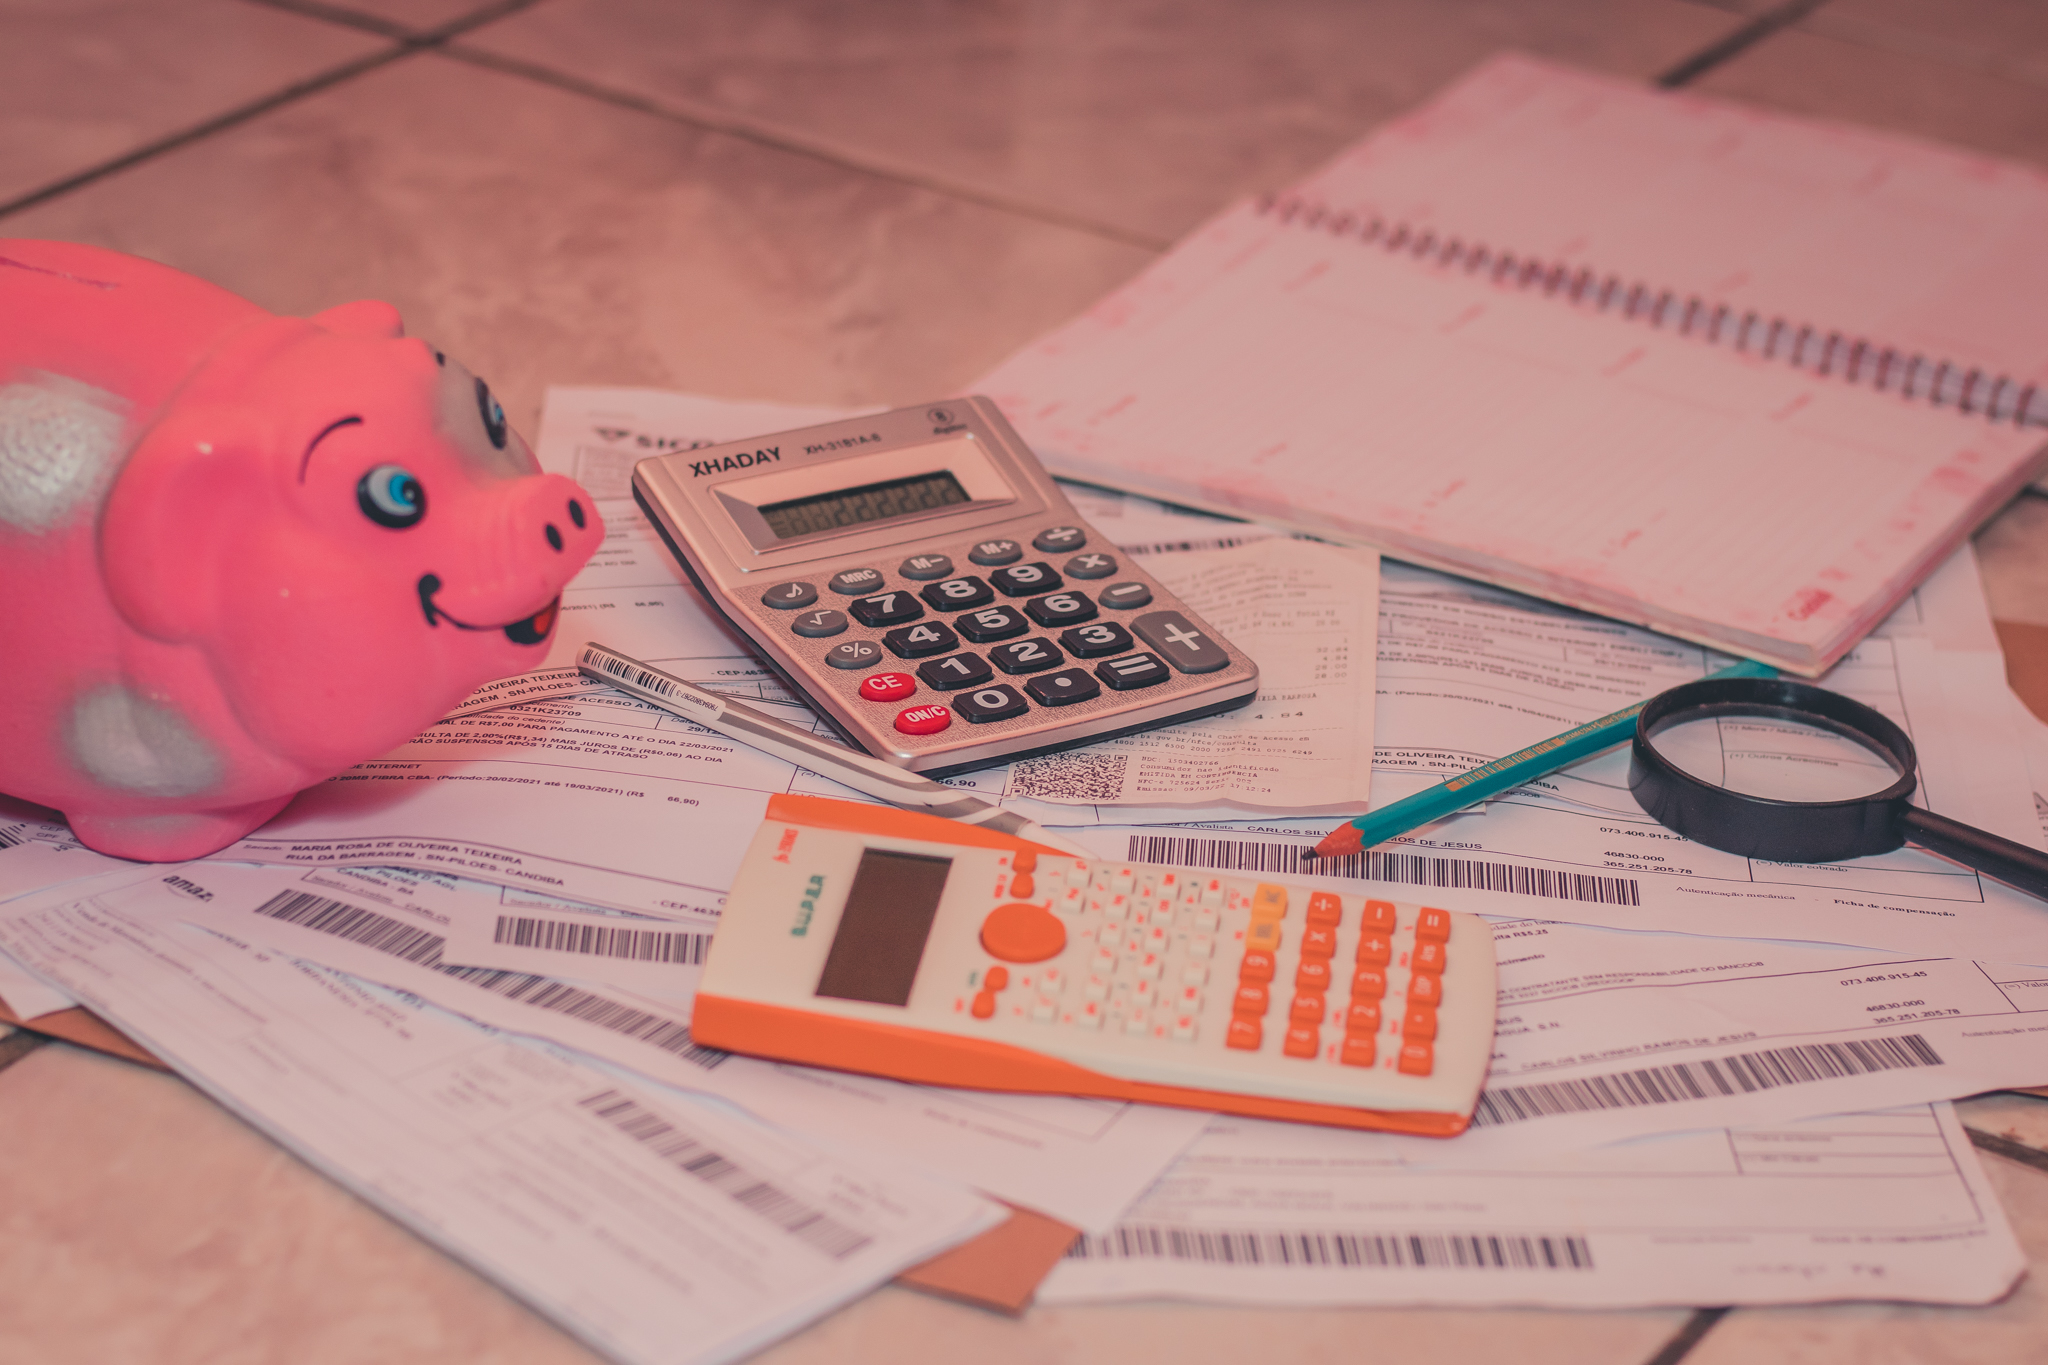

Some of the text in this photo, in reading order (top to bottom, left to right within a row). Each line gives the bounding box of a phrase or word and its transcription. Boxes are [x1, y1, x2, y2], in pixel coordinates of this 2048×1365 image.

[688, 446, 781, 477] XHADAY
[979, 541, 1013, 555] M+
[839, 569, 877, 585] MRC
[1007, 565, 1043, 583] 9
[940, 580, 977, 598] 8
[866, 594, 897, 613] 7
[1044, 594, 1080, 613] 6
[974, 609, 1010, 628] 5
[908, 625, 941, 643] 4
[1079, 625, 1116, 644] 3
[1008, 642, 1048, 662] 2
[940, 657, 971, 675] 1
[472, 670, 585, 696] OLIVEIRA TEIXEIRA
[868, 675, 902, 690] CE
[578, 696, 632, 708] ACESSO
[973, 690, 1009, 708] 0
[509, 705, 582, 717] 0321K23709
[905, 705, 946, 723] ON/C
[522, 717, 566, 726] cedente)
[479, 721, 514, 729] R$7,00
[550, 727, 620, 739] PAGAMENTO
[621, 733, 645, 742] ATÉ
[658, 739, 677, 747] DIA
[679, 741, 734, 754] 22/03/2021
[1192, 731, 1213, 739] pela
[435, 738, 504, 746] SUSPENSOS
[505, 739, 537, 749] APÓS
[555, 744, 581, 752] DIAS
[602, 749, 648, 759] ATRASO
[474, 732, 547, 744] 2,00%(R$1,34)
[550, 737, 577, 746] MAIS
[579, 741, 618, 750] JUROS
[639, 747, 683, 759] (R$0,06)
[685, 753, 702, 761] AO
[1165, 742, 1186, 750] 6500
[1396, 751, 1454, 761] OLIVEIRA
[1139, 771, 1176, 779] EMITIDA
[1140, 763, 1191, 773] Consumidor
[1218, 763, 1280, 773] identificado
[544, 779, 561, 787] até
[564, 782, 624, 796] 19/03/2021)
[626, 790, 645, 799] (R$
[667, 796, 699, 807] 66,90)
[1229, 783, 1271, 793] 17:12:24
[1247, 825, 1301, 836] CARLOS
[1600, 826, 1689, 843] 073.406.915-45
[1419, 838, 1483, 850] DE JESUS
[291, 844, 333, 852] MARIA
[335, 842, 372, 851] ROSA
[398, 842, 459, 853] OLIVEIRA
[463, 847, 523, 866] TEIXEIRA
[1603, 850, 1665, 863] 46830-000
[317, 853, 335, 861] DA
[339, 851, 416, 860] BARRAGEM
[505, 867, 565, 887] CANDIBA
[1602, 860, 1693, 875] 365.251.205-78
[1806, 862, 1849, 873] cobrado
[1676, 886, 1796, 901] Autenticação mecânica
[1833, 898, 1865, 907] Ficha
[1882, 905, 1956, 918] compensação
[1605, 967, 1698, 979] RESPONSABILIDADE
[1700, 965, 1716, 973] DO
[1717, 960, 1764, 971] BANCOOB
[1840, 970, 1928, 987] 073.406.915-45
[1866, 999, 1925, 1012] 46830-000
[1873, 1008, 1961, 1025] 365.251.205-78
